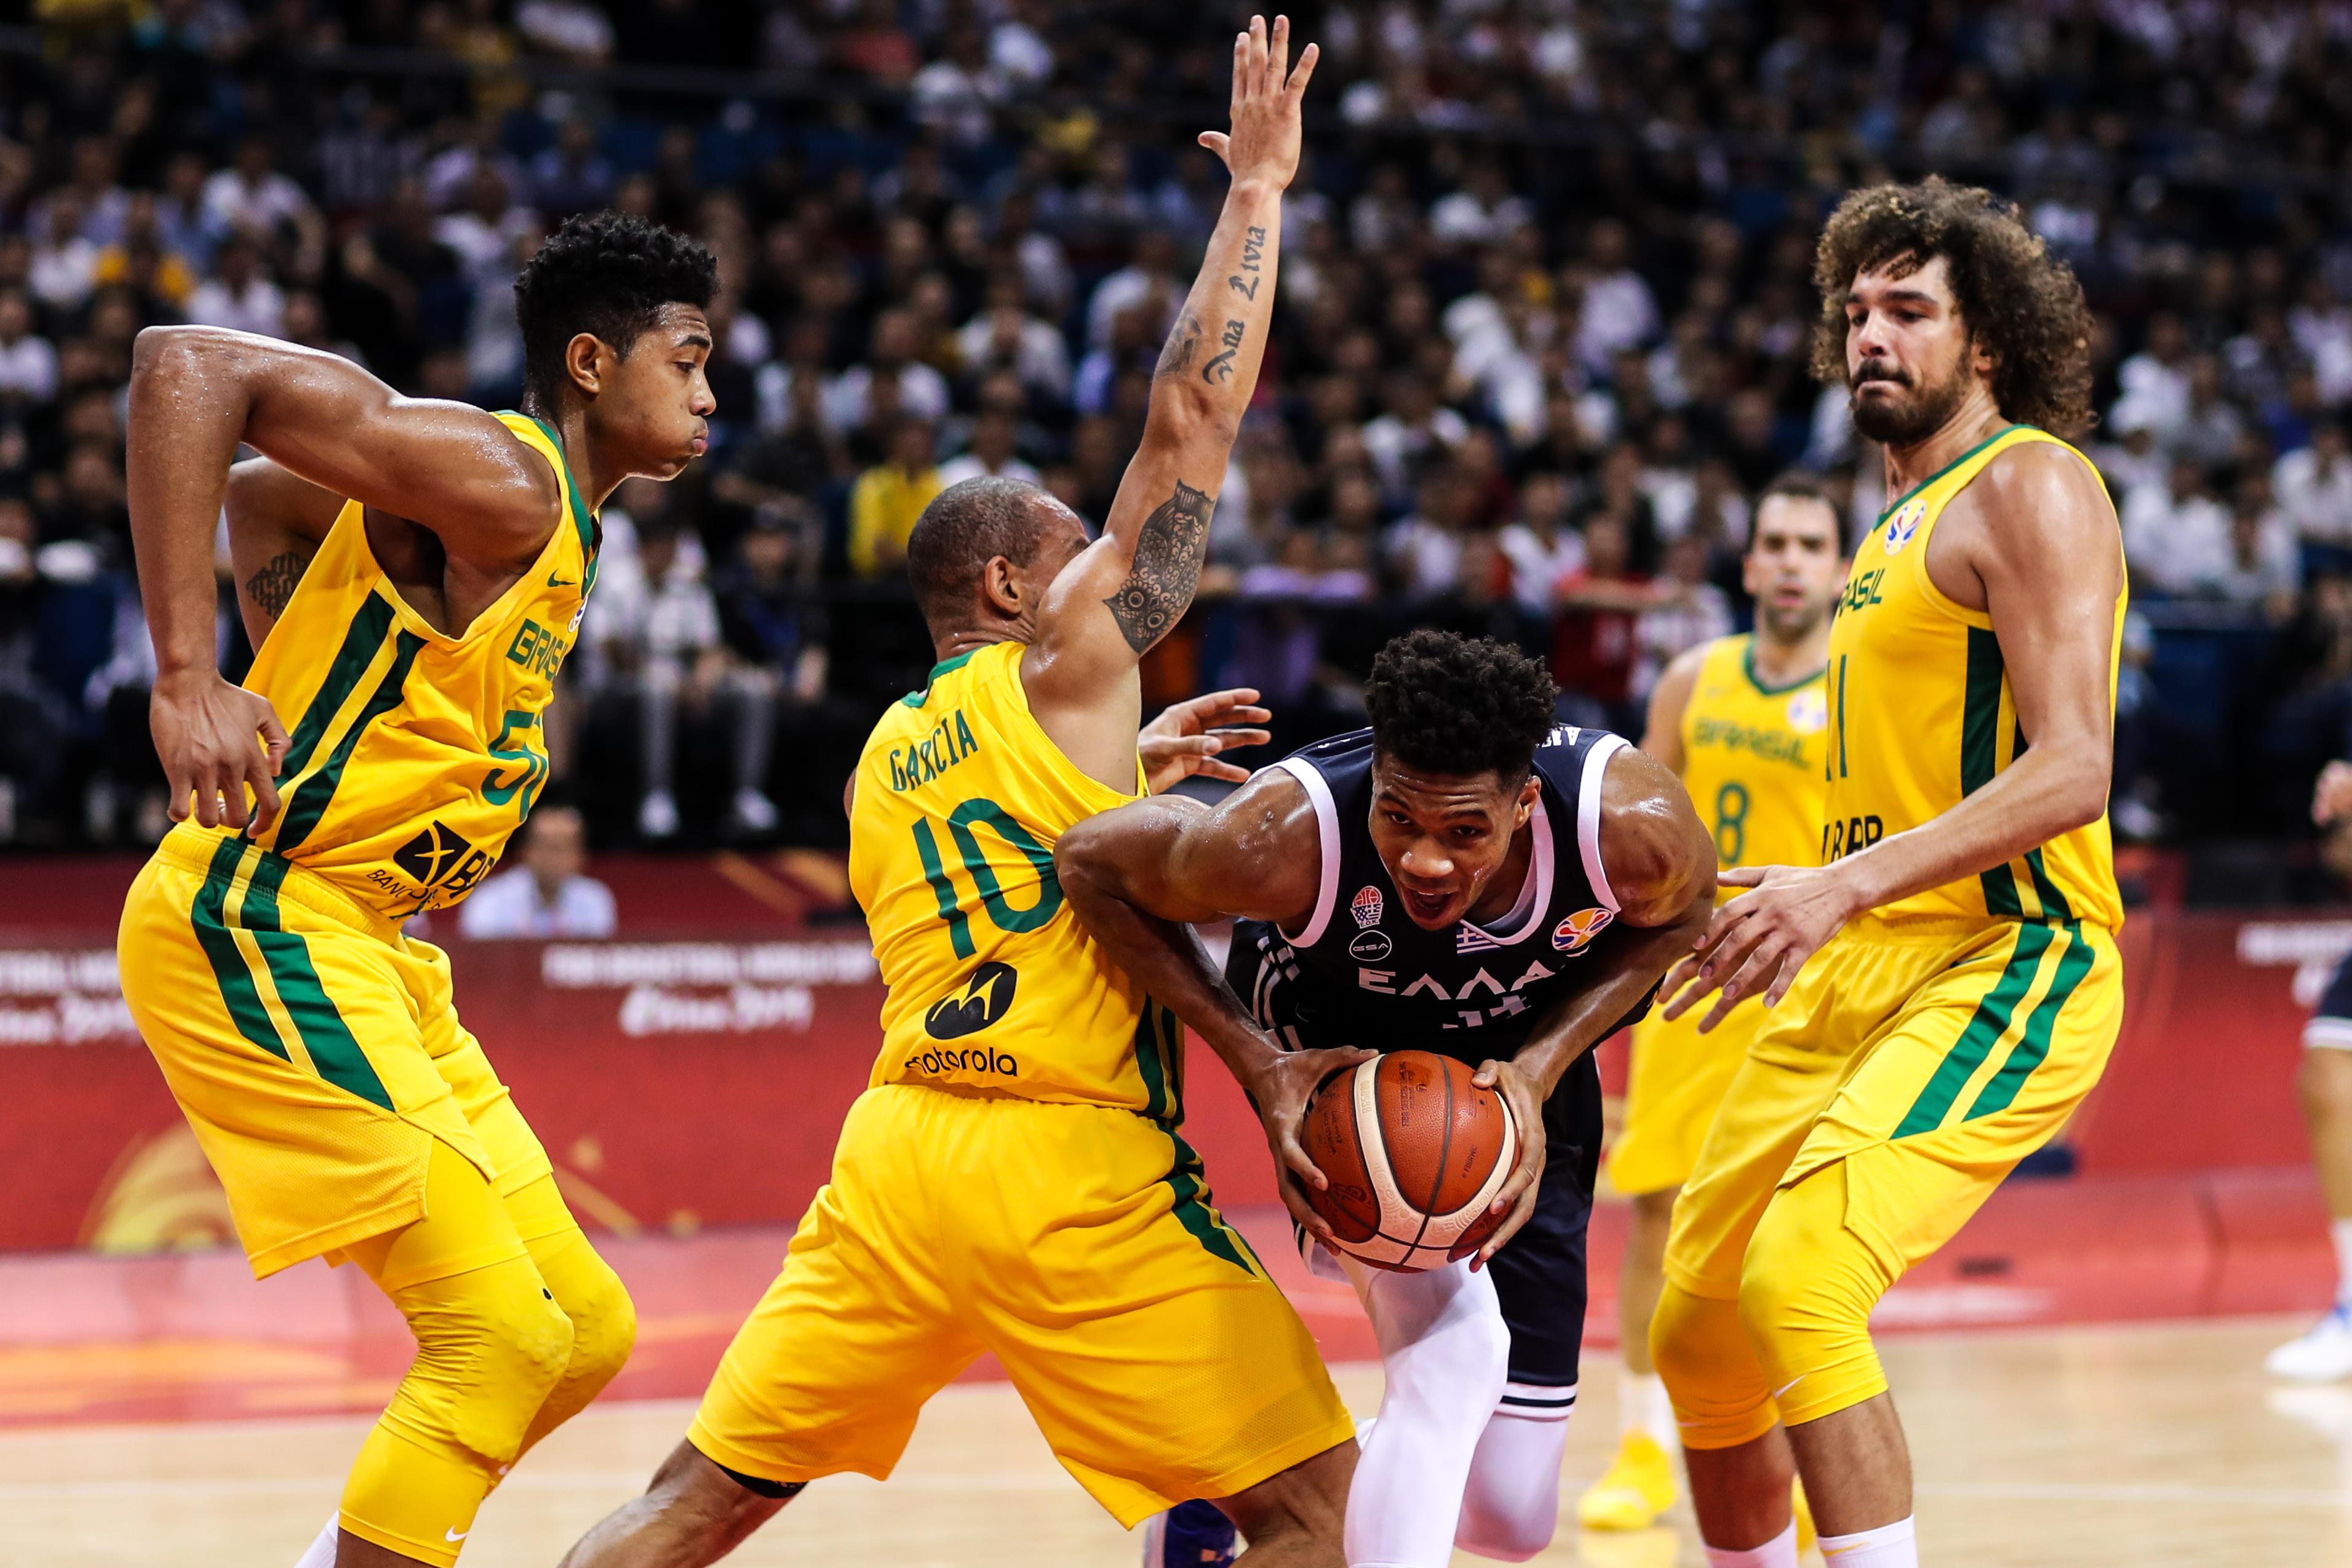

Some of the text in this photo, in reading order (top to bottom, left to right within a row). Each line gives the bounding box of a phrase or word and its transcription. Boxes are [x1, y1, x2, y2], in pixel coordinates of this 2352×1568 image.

[1202, 320, 1245, 385] Ana
[890, 709, 978, 791] GARCIA
[1715, 783, 1749, 865] 8
[911, 798, 1065, 961] 10
[1359, 960, 1558, 1000] ΕΛΛΑ
